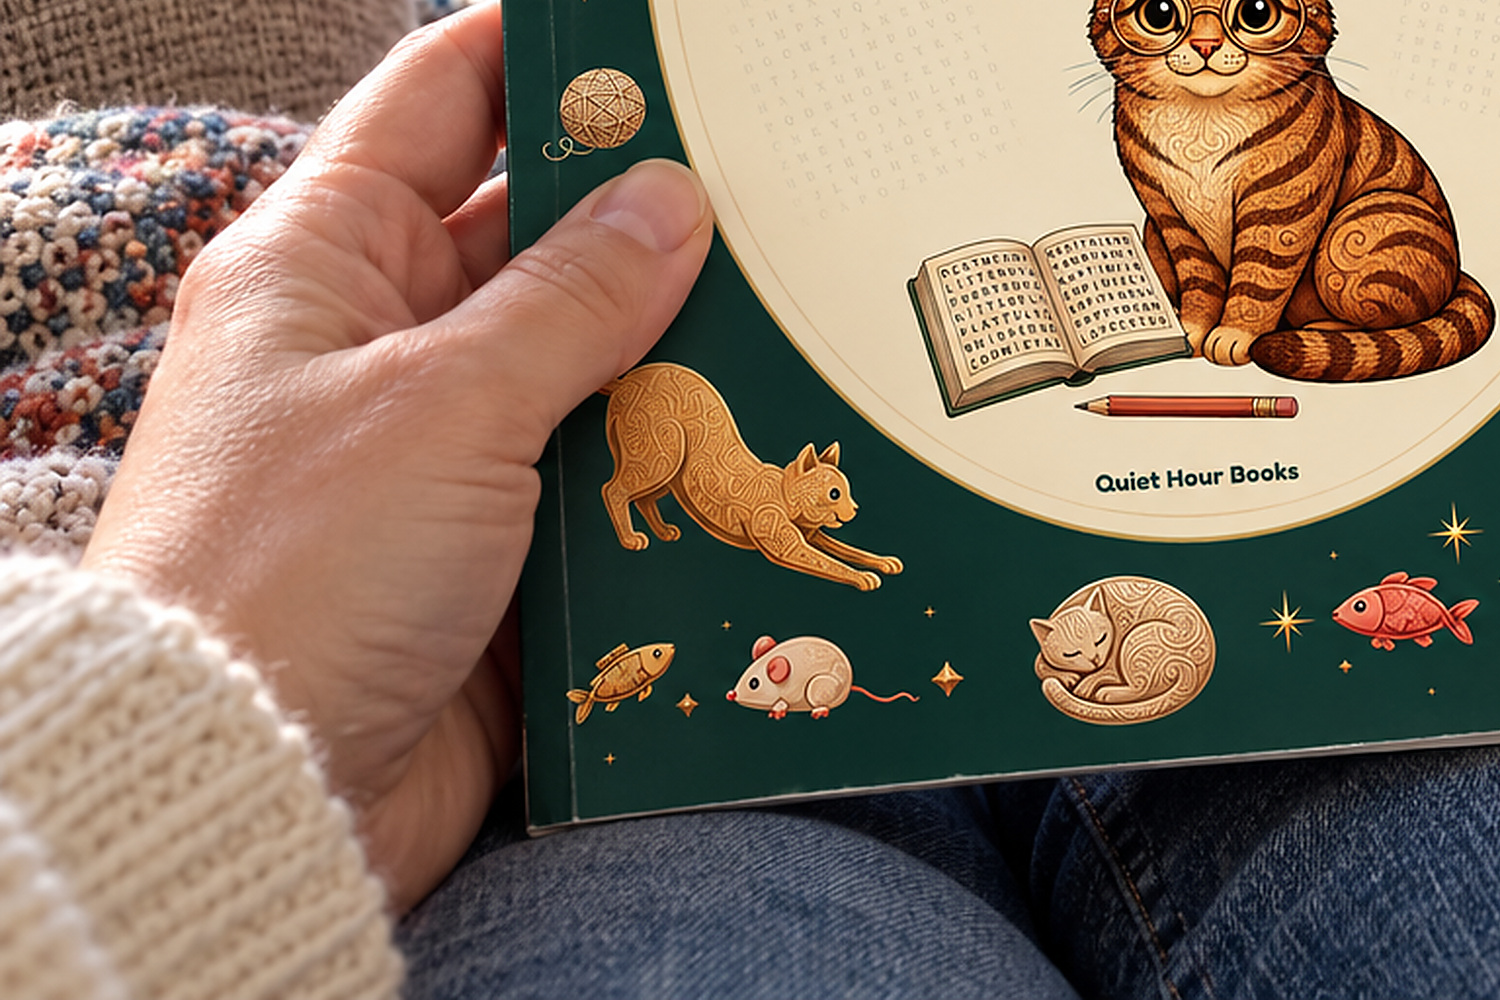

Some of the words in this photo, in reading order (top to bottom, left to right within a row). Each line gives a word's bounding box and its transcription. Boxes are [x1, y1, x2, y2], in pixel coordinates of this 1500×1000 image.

[1096, 472, 1160, 492] Quiet
[1167, 469, 1224, 488] Hour
[1230, 462, 1299, 484] Books
